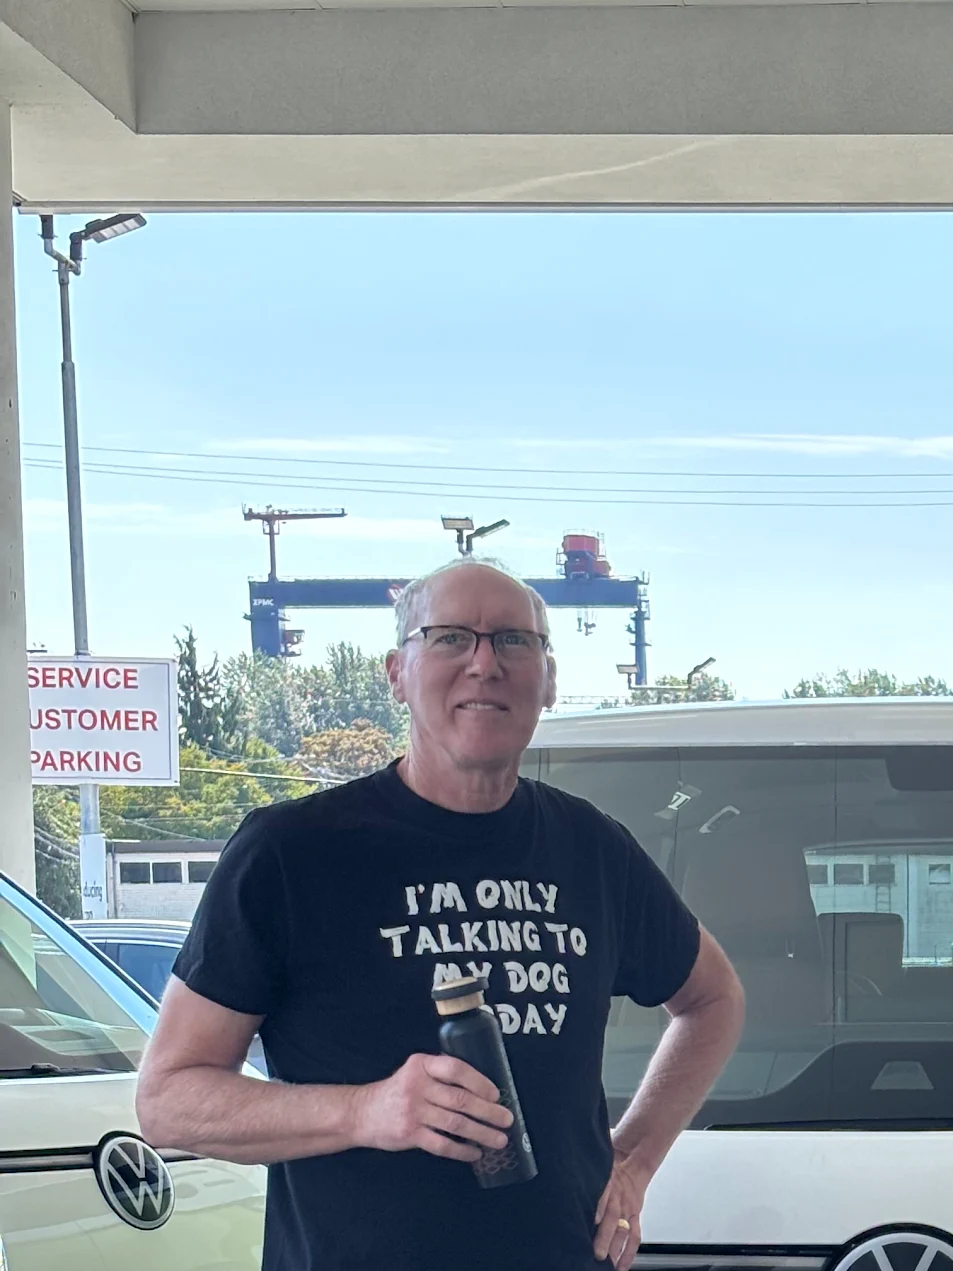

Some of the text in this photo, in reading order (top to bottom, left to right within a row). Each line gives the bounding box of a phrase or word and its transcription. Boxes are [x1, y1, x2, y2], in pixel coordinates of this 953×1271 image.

[28, 667, 139, 689] SERVICE
[29, 709, 158, 731] USTOMER
[405, 879, 559, 915] I'M ONLY
[379, 920, 588, 957] TALKING TO
[503, 961, 571, 993] DOG
